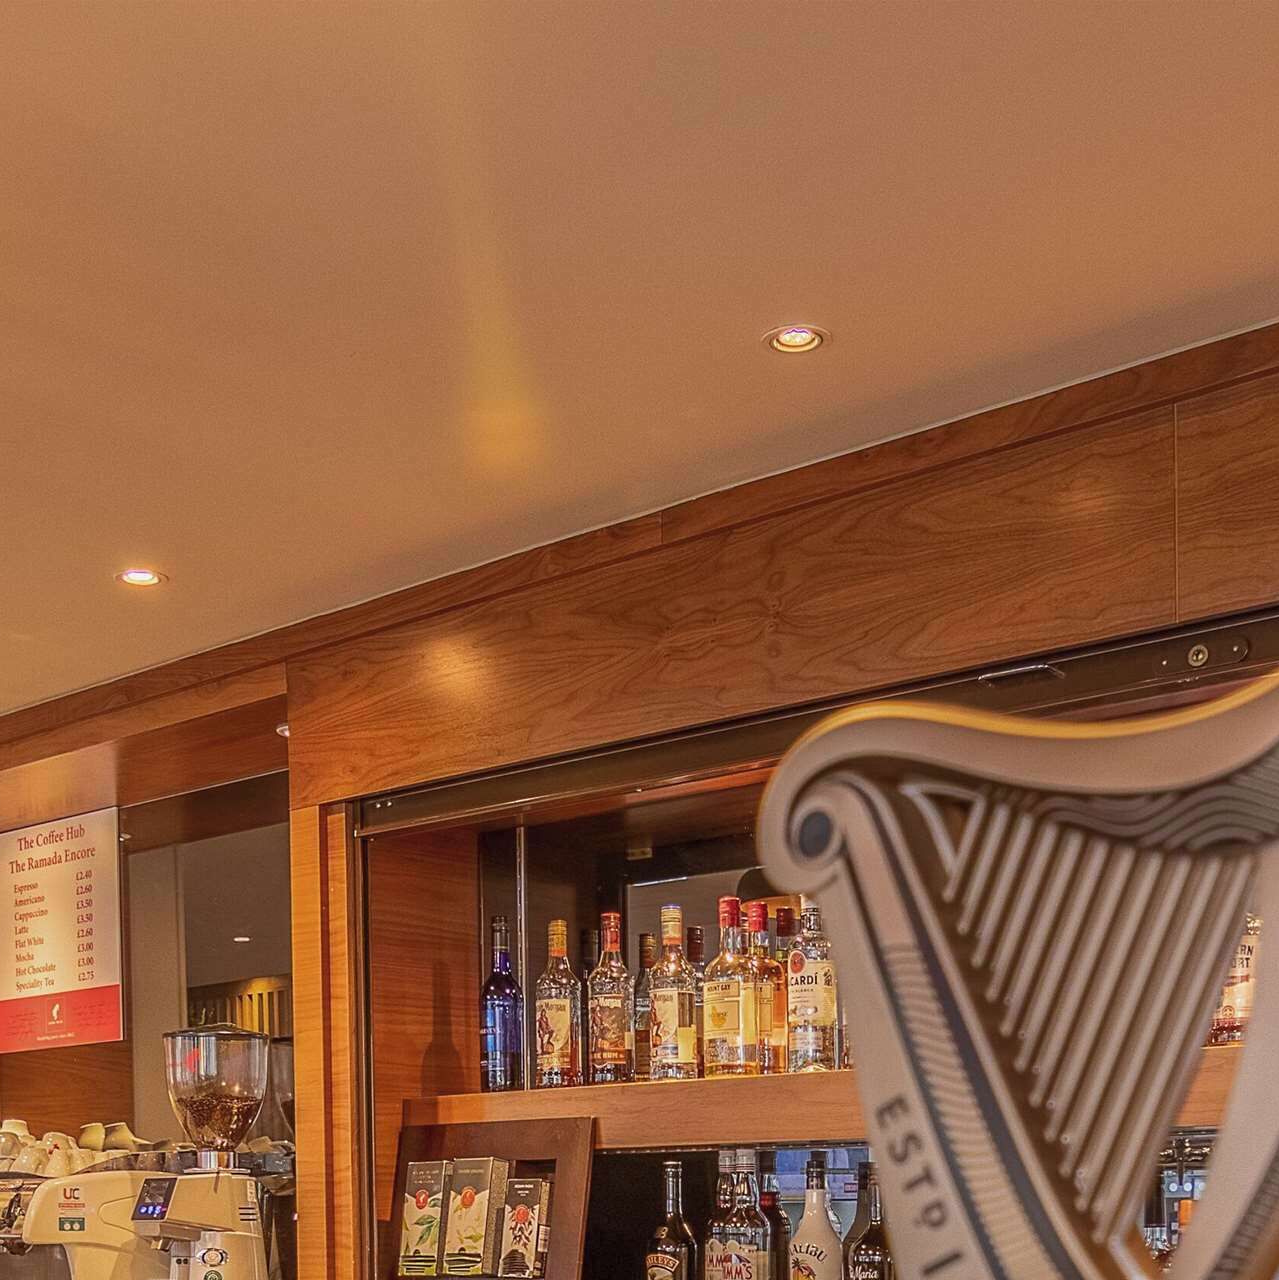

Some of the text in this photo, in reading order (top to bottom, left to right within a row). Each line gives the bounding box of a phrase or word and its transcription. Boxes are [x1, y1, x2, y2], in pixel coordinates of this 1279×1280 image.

[17, 824, 85, 851] The Coffee Hub
[9, 846, 96, 874] The Ramada Encore
[14, 870, 93, 895] Espresso £2.40
[14, 883, 93, 907] Americano £2.60
[14, 909, 49, 923] Cappuccino
[14, 925, 29, 935] Latte
[15, 940, 26, 949] Flat
[27, 937, 44, 947] White
[15, 942, 94, 963] Mocha £3.00
[15, 957, 94, 977] Hot Chocolate £3.00
[45, 977, 55, 986] Tea
[78, 971, 95, 982] £2.75
[63, 1187, 80, 1200] UC
